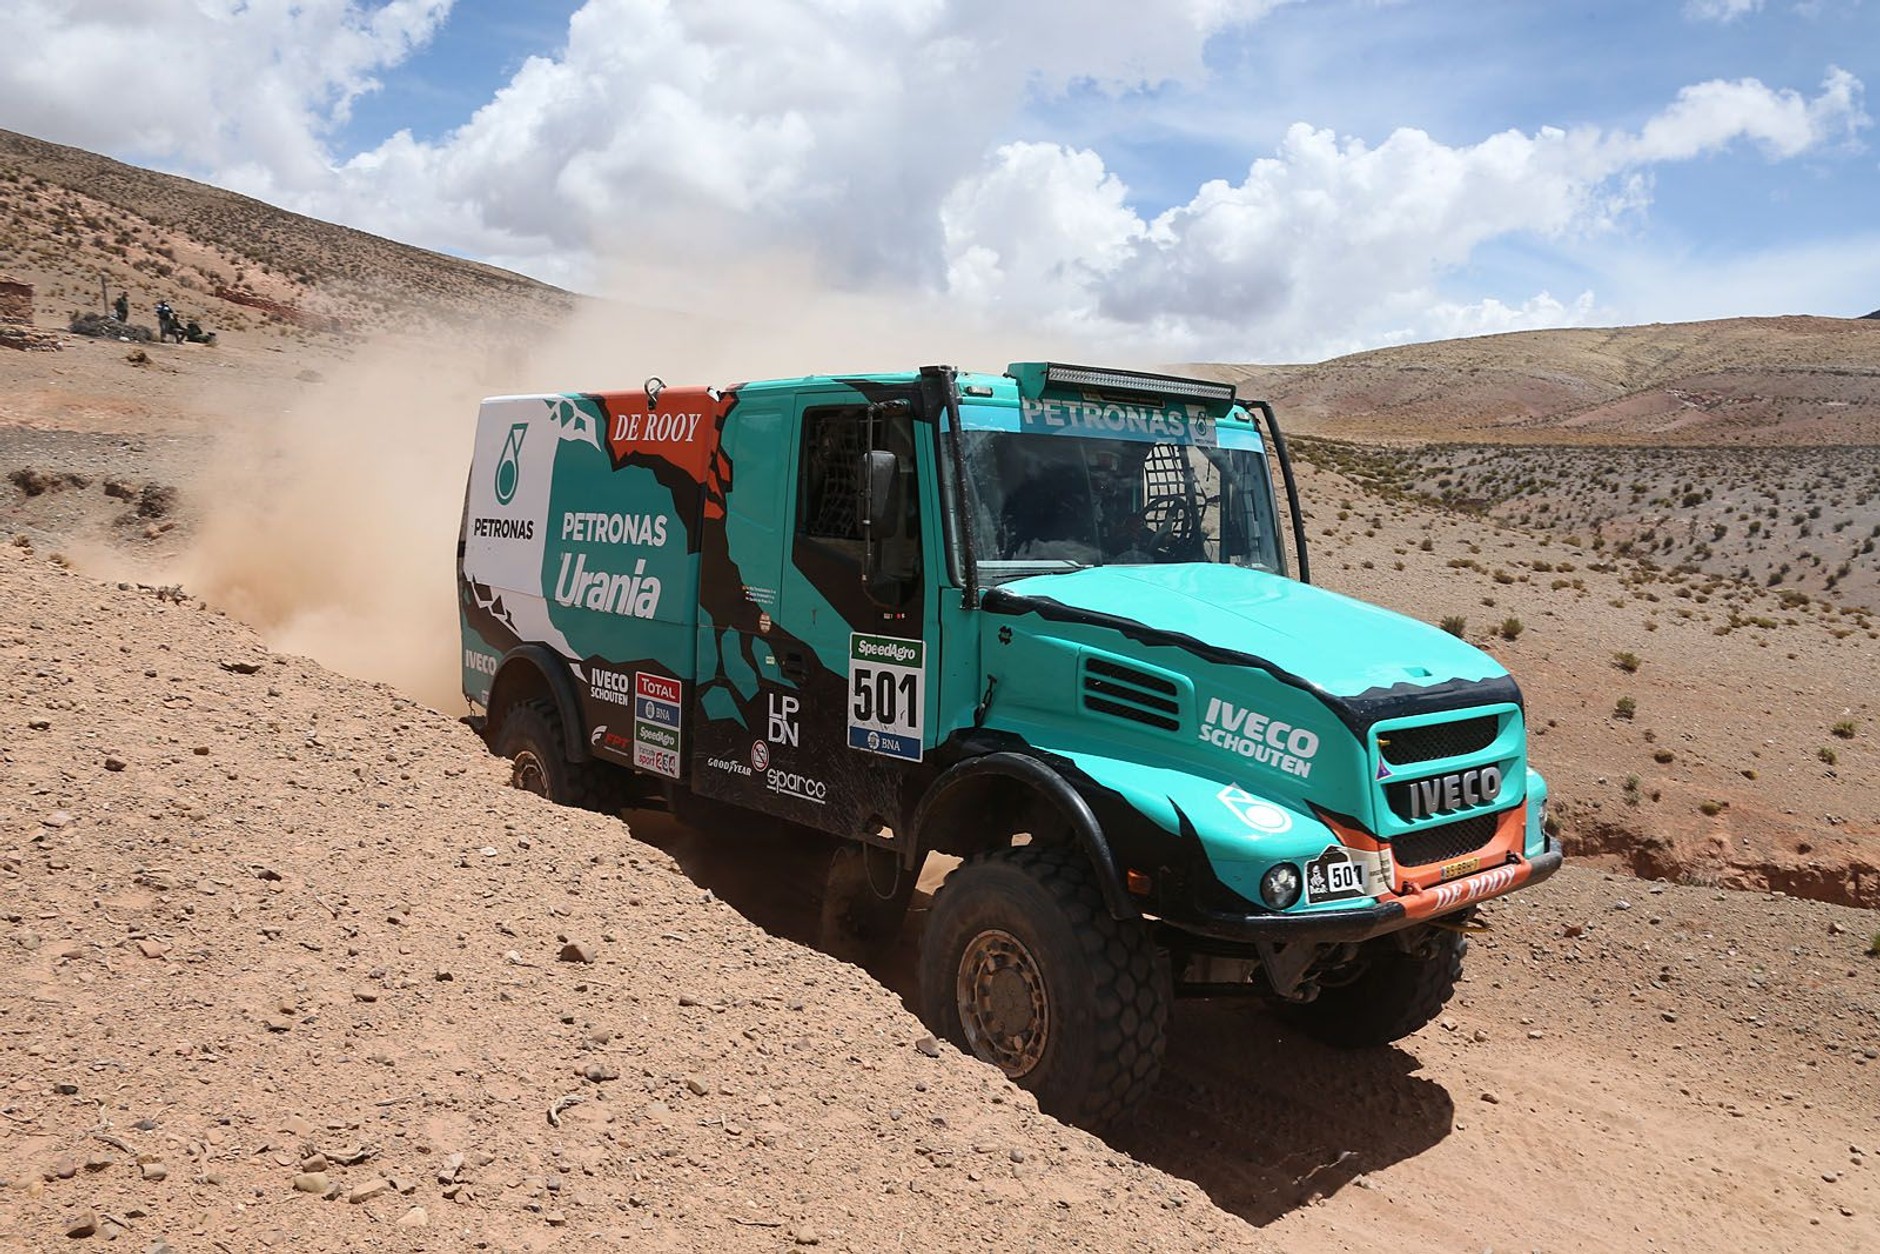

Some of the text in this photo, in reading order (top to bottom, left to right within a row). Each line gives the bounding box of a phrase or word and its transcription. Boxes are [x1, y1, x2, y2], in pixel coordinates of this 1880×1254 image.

[613, 413, 702, 442] DE ROOY
[1021, 396, 1186, 437] PETRONAS
[473, 518, 534, 540] PETRONAS
[561, 512, 668, 547] PETRONAS
[465, 649, 497, 676] IVECO
[858, 639, 916, 662] SpeedAgro
[591, 667, 629, 693] IVECO
[641, 678, 676, 699] TOTAL
[590, 686, 629, 707] SCHOUTEN
[768, 693, 799, 721] LP
[853, 668, 918, 728] 501
[640, 726, 675, 747] SpeedAgro
[1204, 697, 1319, 758] IVECO
[881, 738, 901, 752] BNA
[1198, 723, 1313, 779] SCHOUTEN
[707, 757, 752, 776] GOODYEAR
[767, 768, 826, 798] sparco
[1409, 766, 1502, 819] IVECO
[1332, 864, 1362, 888] 501
[1432, 883, 1463, 911] DE
